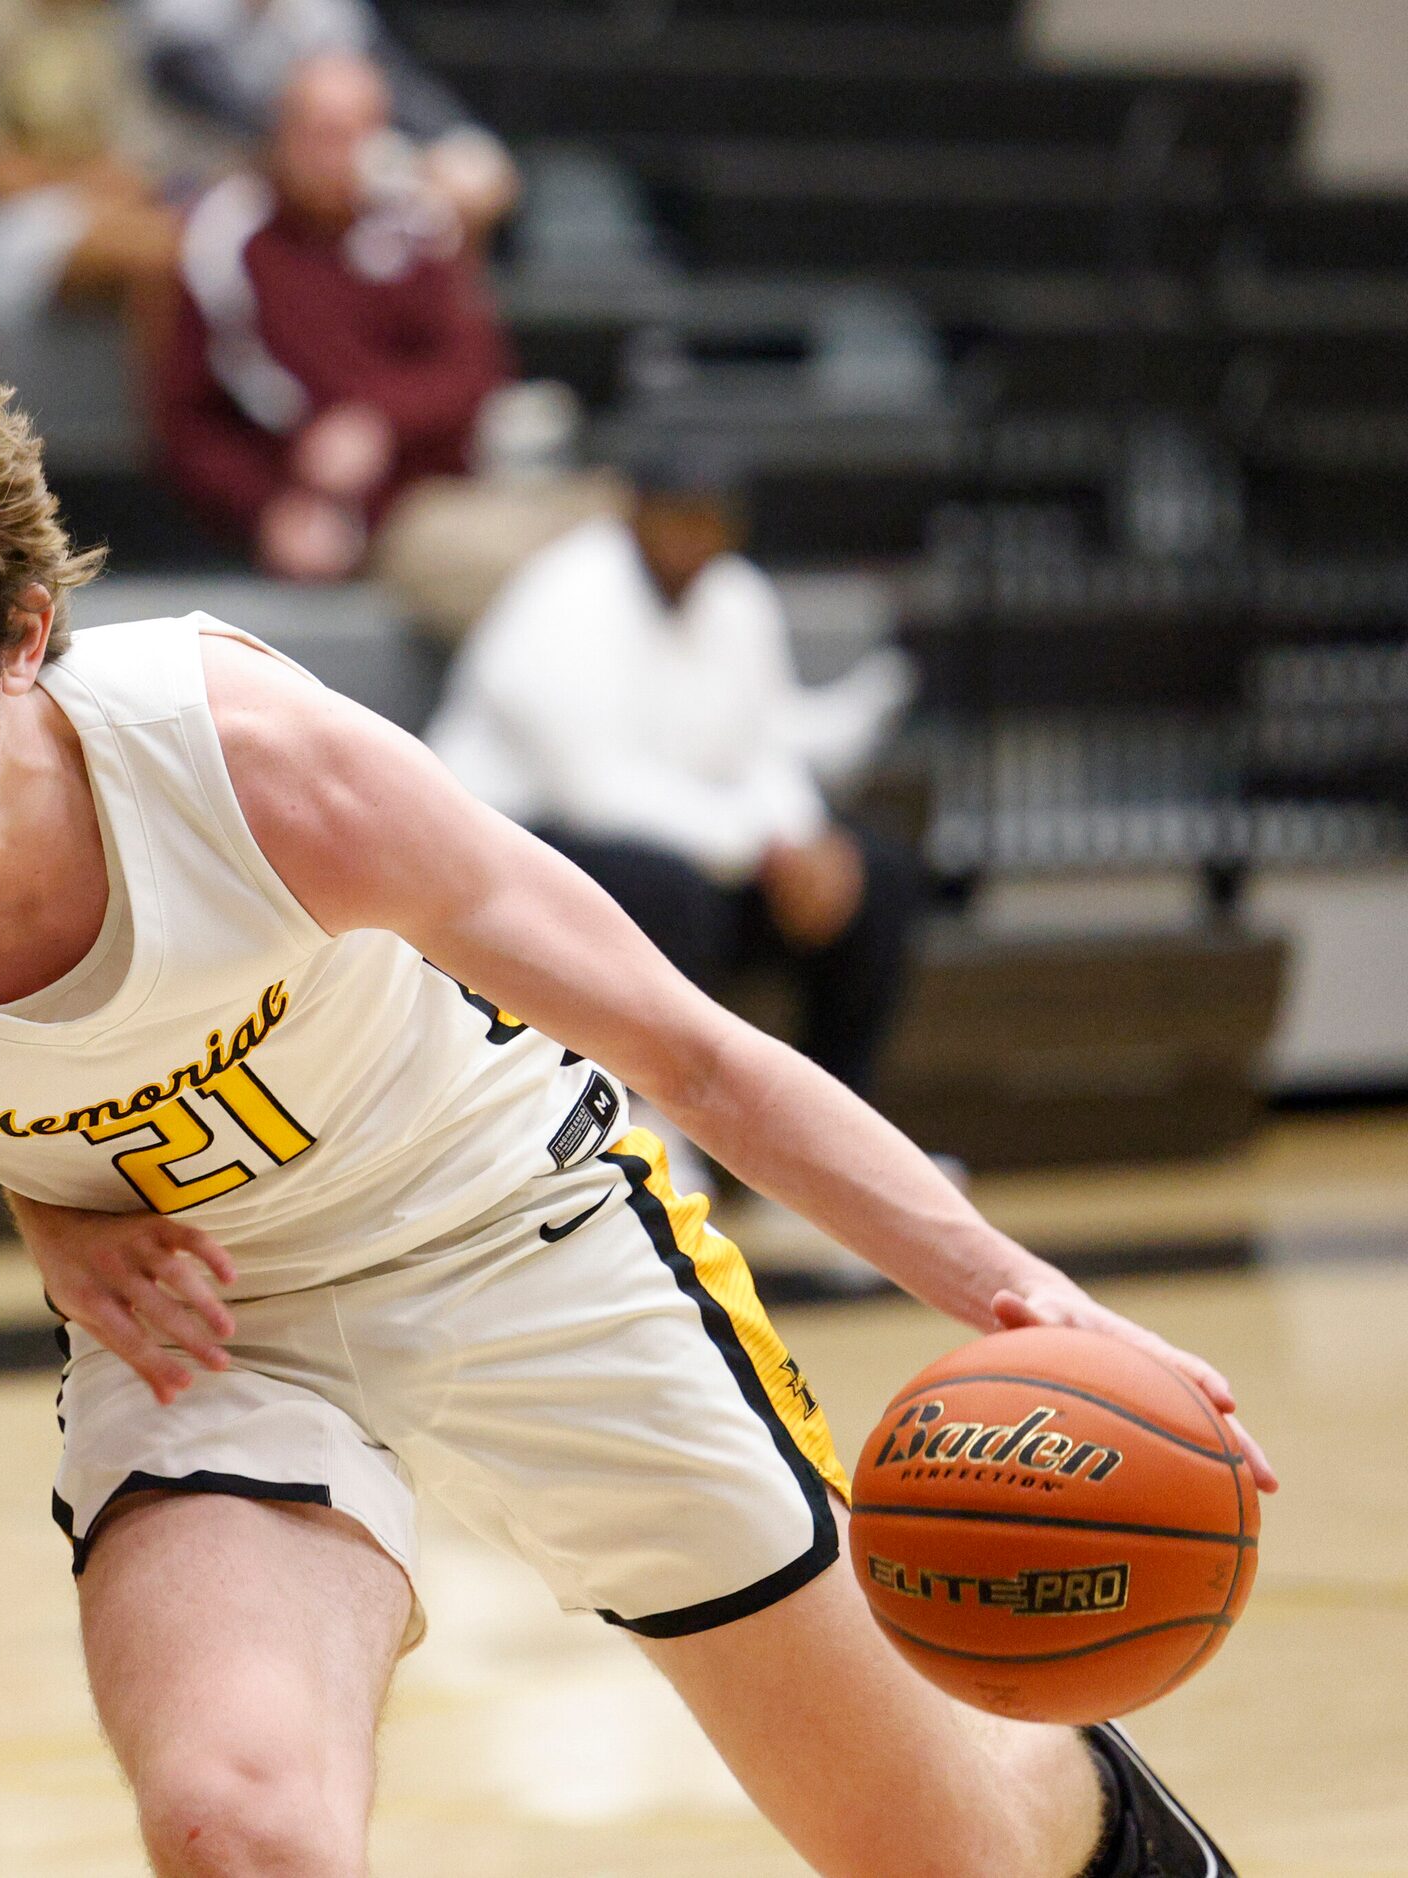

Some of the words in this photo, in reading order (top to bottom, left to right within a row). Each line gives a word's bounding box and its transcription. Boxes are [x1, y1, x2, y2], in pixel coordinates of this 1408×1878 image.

[593, 1090, 611, 1116] M
[80, 1061, 317, 1214] 21
[554, 1107, 586, 1153] ENGINEERED
[874, 1400, 1122, 1482] Baden
[901, 1467, 1055, 1492] PERFECTION
